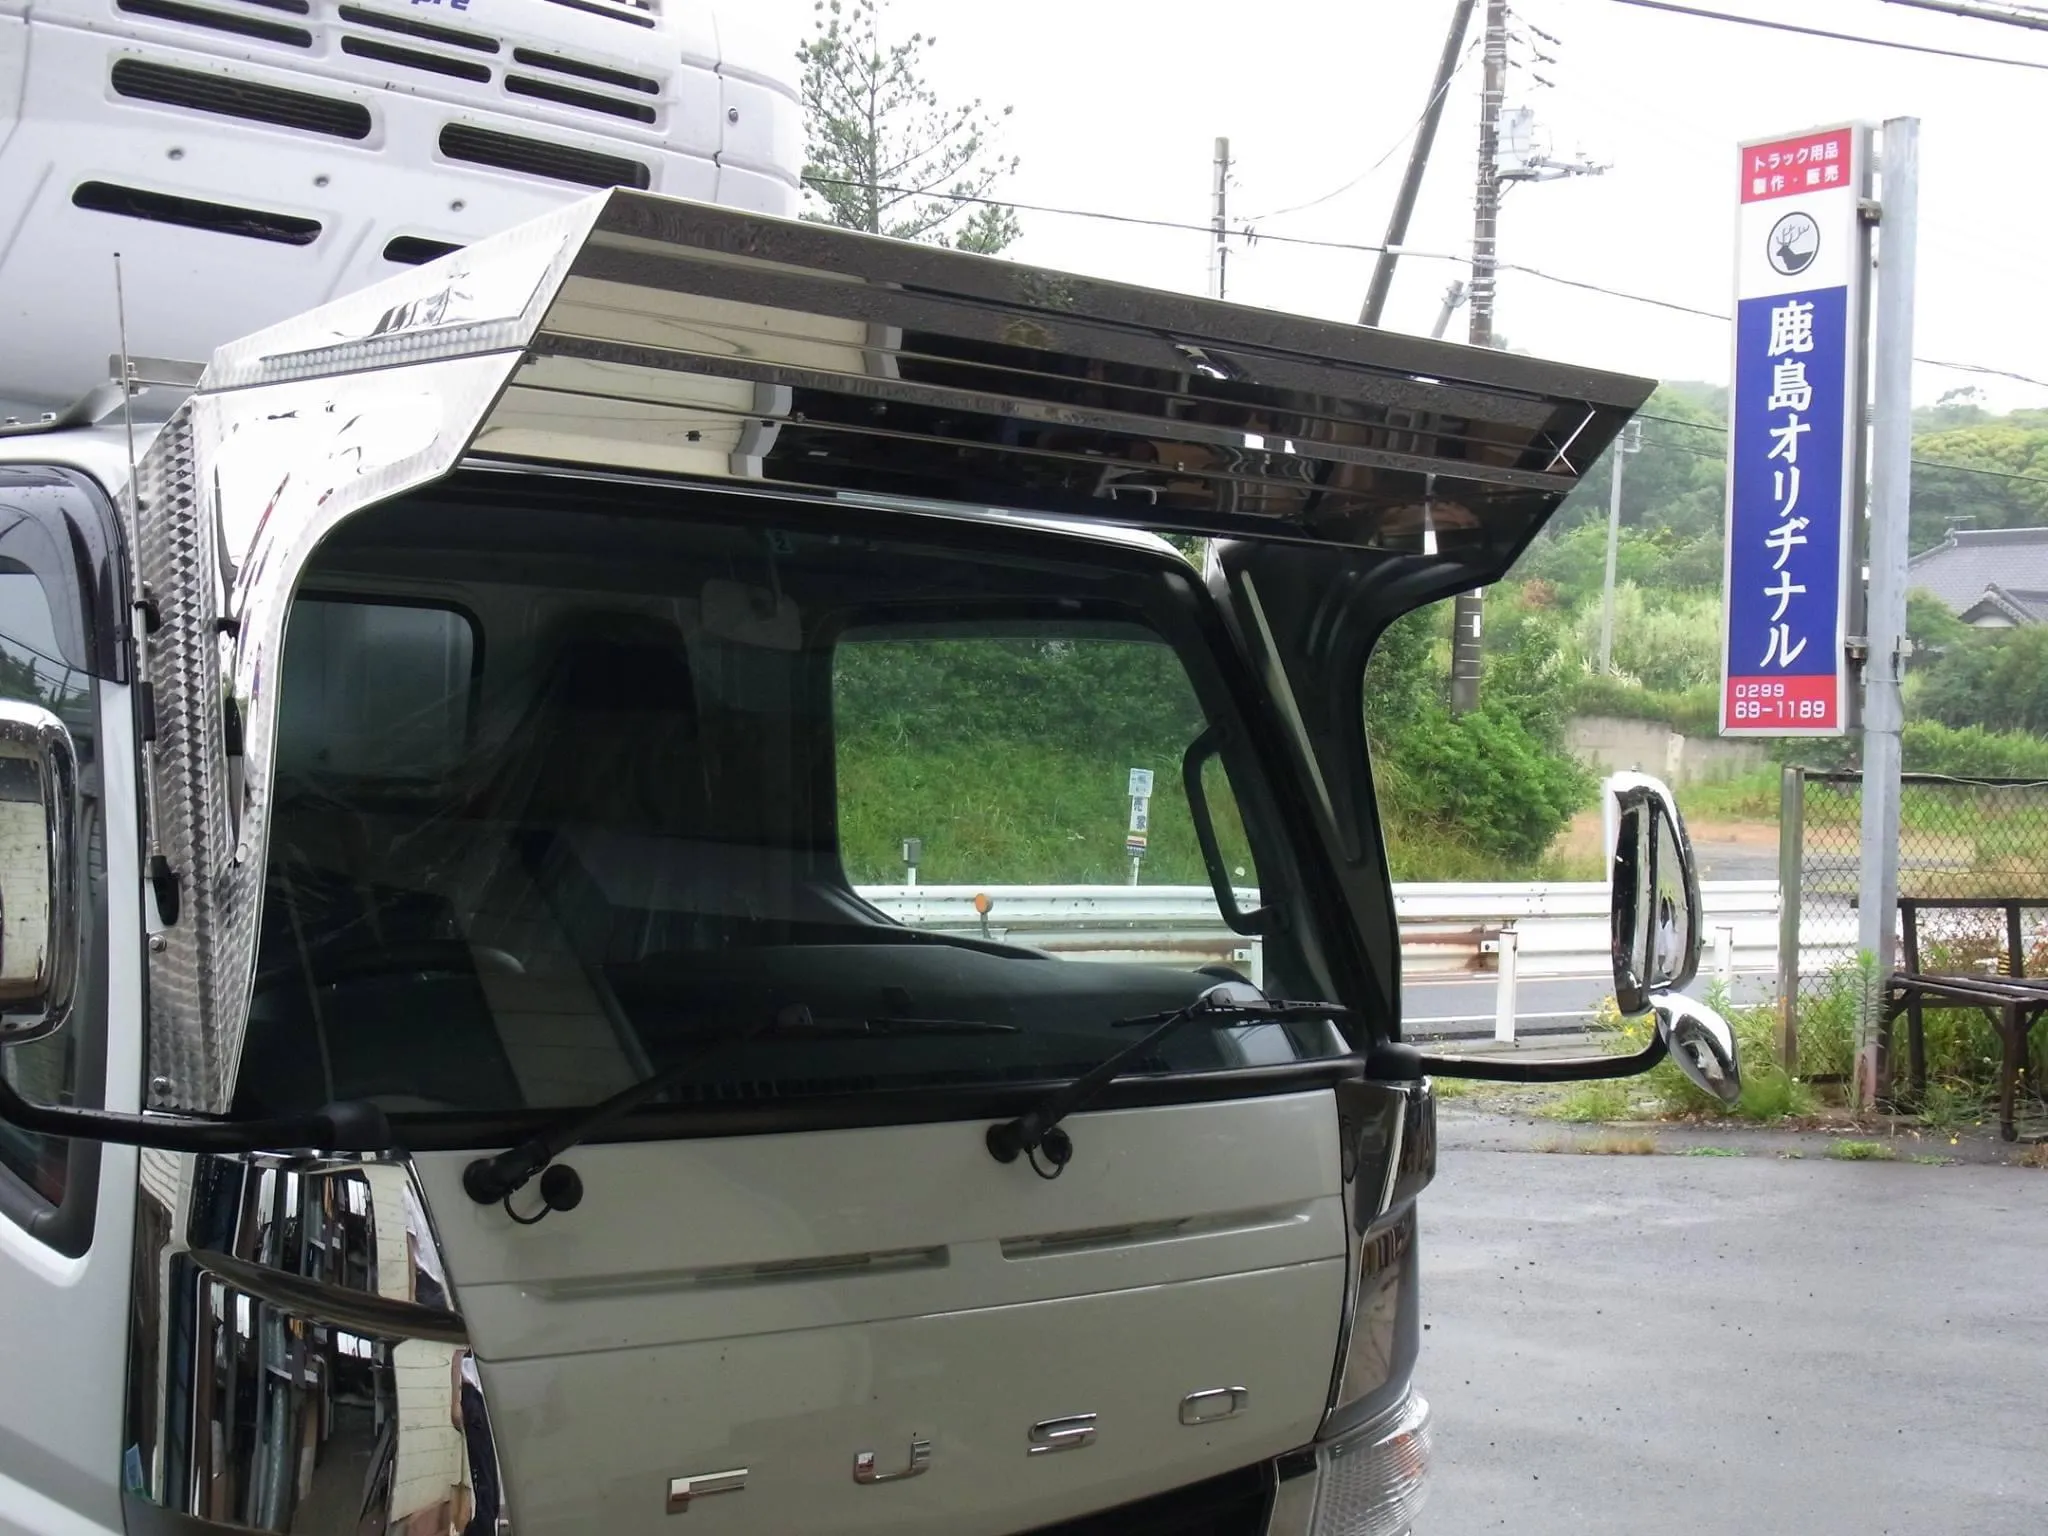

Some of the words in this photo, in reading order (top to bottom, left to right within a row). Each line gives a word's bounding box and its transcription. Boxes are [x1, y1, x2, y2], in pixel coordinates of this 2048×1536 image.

[1754, 141, 1839, 173] トラック用品
[1760, 300, 1815, 668] 鹿島オリヂナル
[1736, 684, 1785, 697] 0299
[1735, 700, 1826, 719] 69-1189
[666, 1386, 1248, 1514] FUSO
